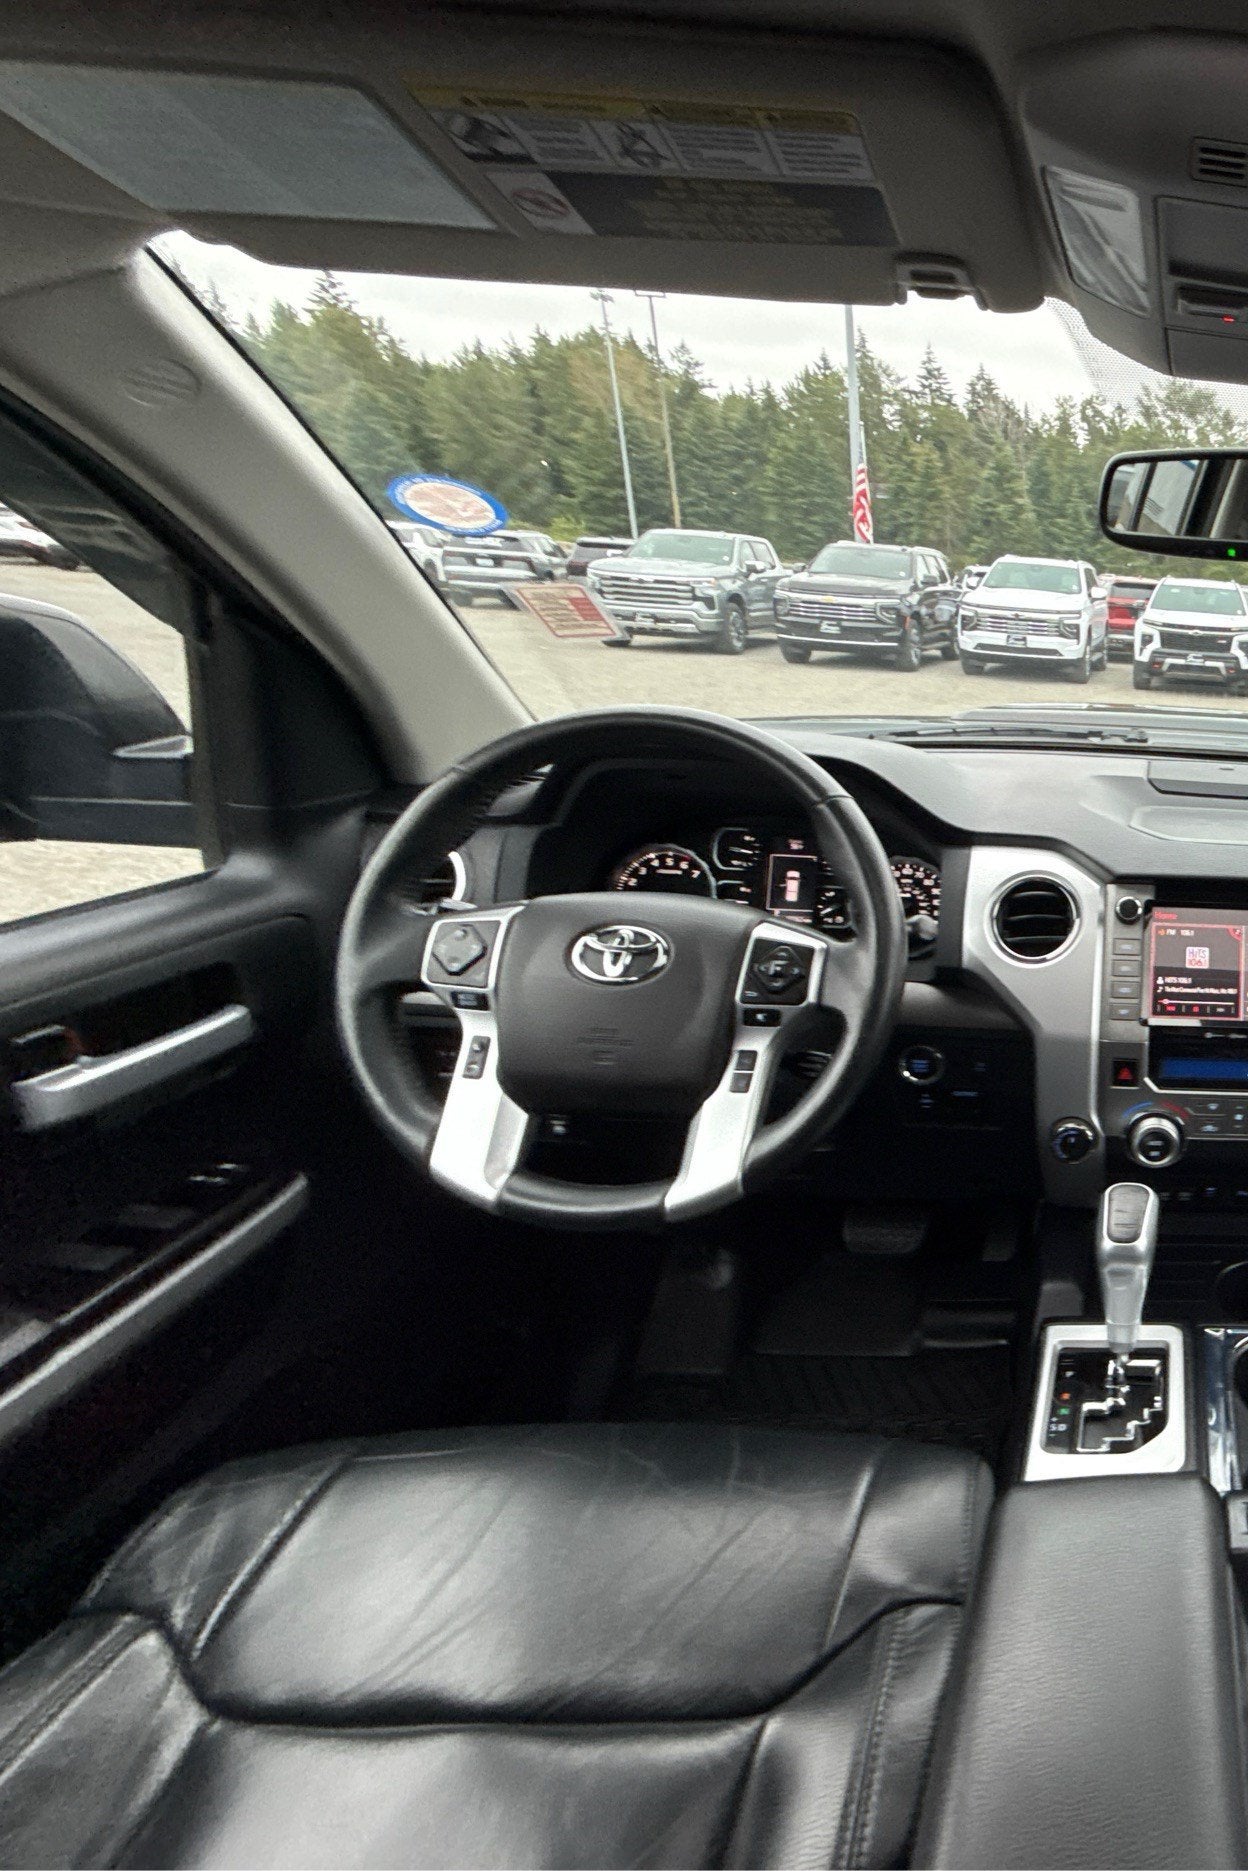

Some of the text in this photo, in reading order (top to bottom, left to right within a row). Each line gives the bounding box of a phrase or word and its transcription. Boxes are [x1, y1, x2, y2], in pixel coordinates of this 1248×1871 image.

[650, 859, 660, 867] 4
[665, 857, 675, 866] 5
[679, 861, 689, 870] 6
[638, 867, 648, 875] 3
[690, 870, 701, 879] 7
[628, 878, 638, 886] 2
